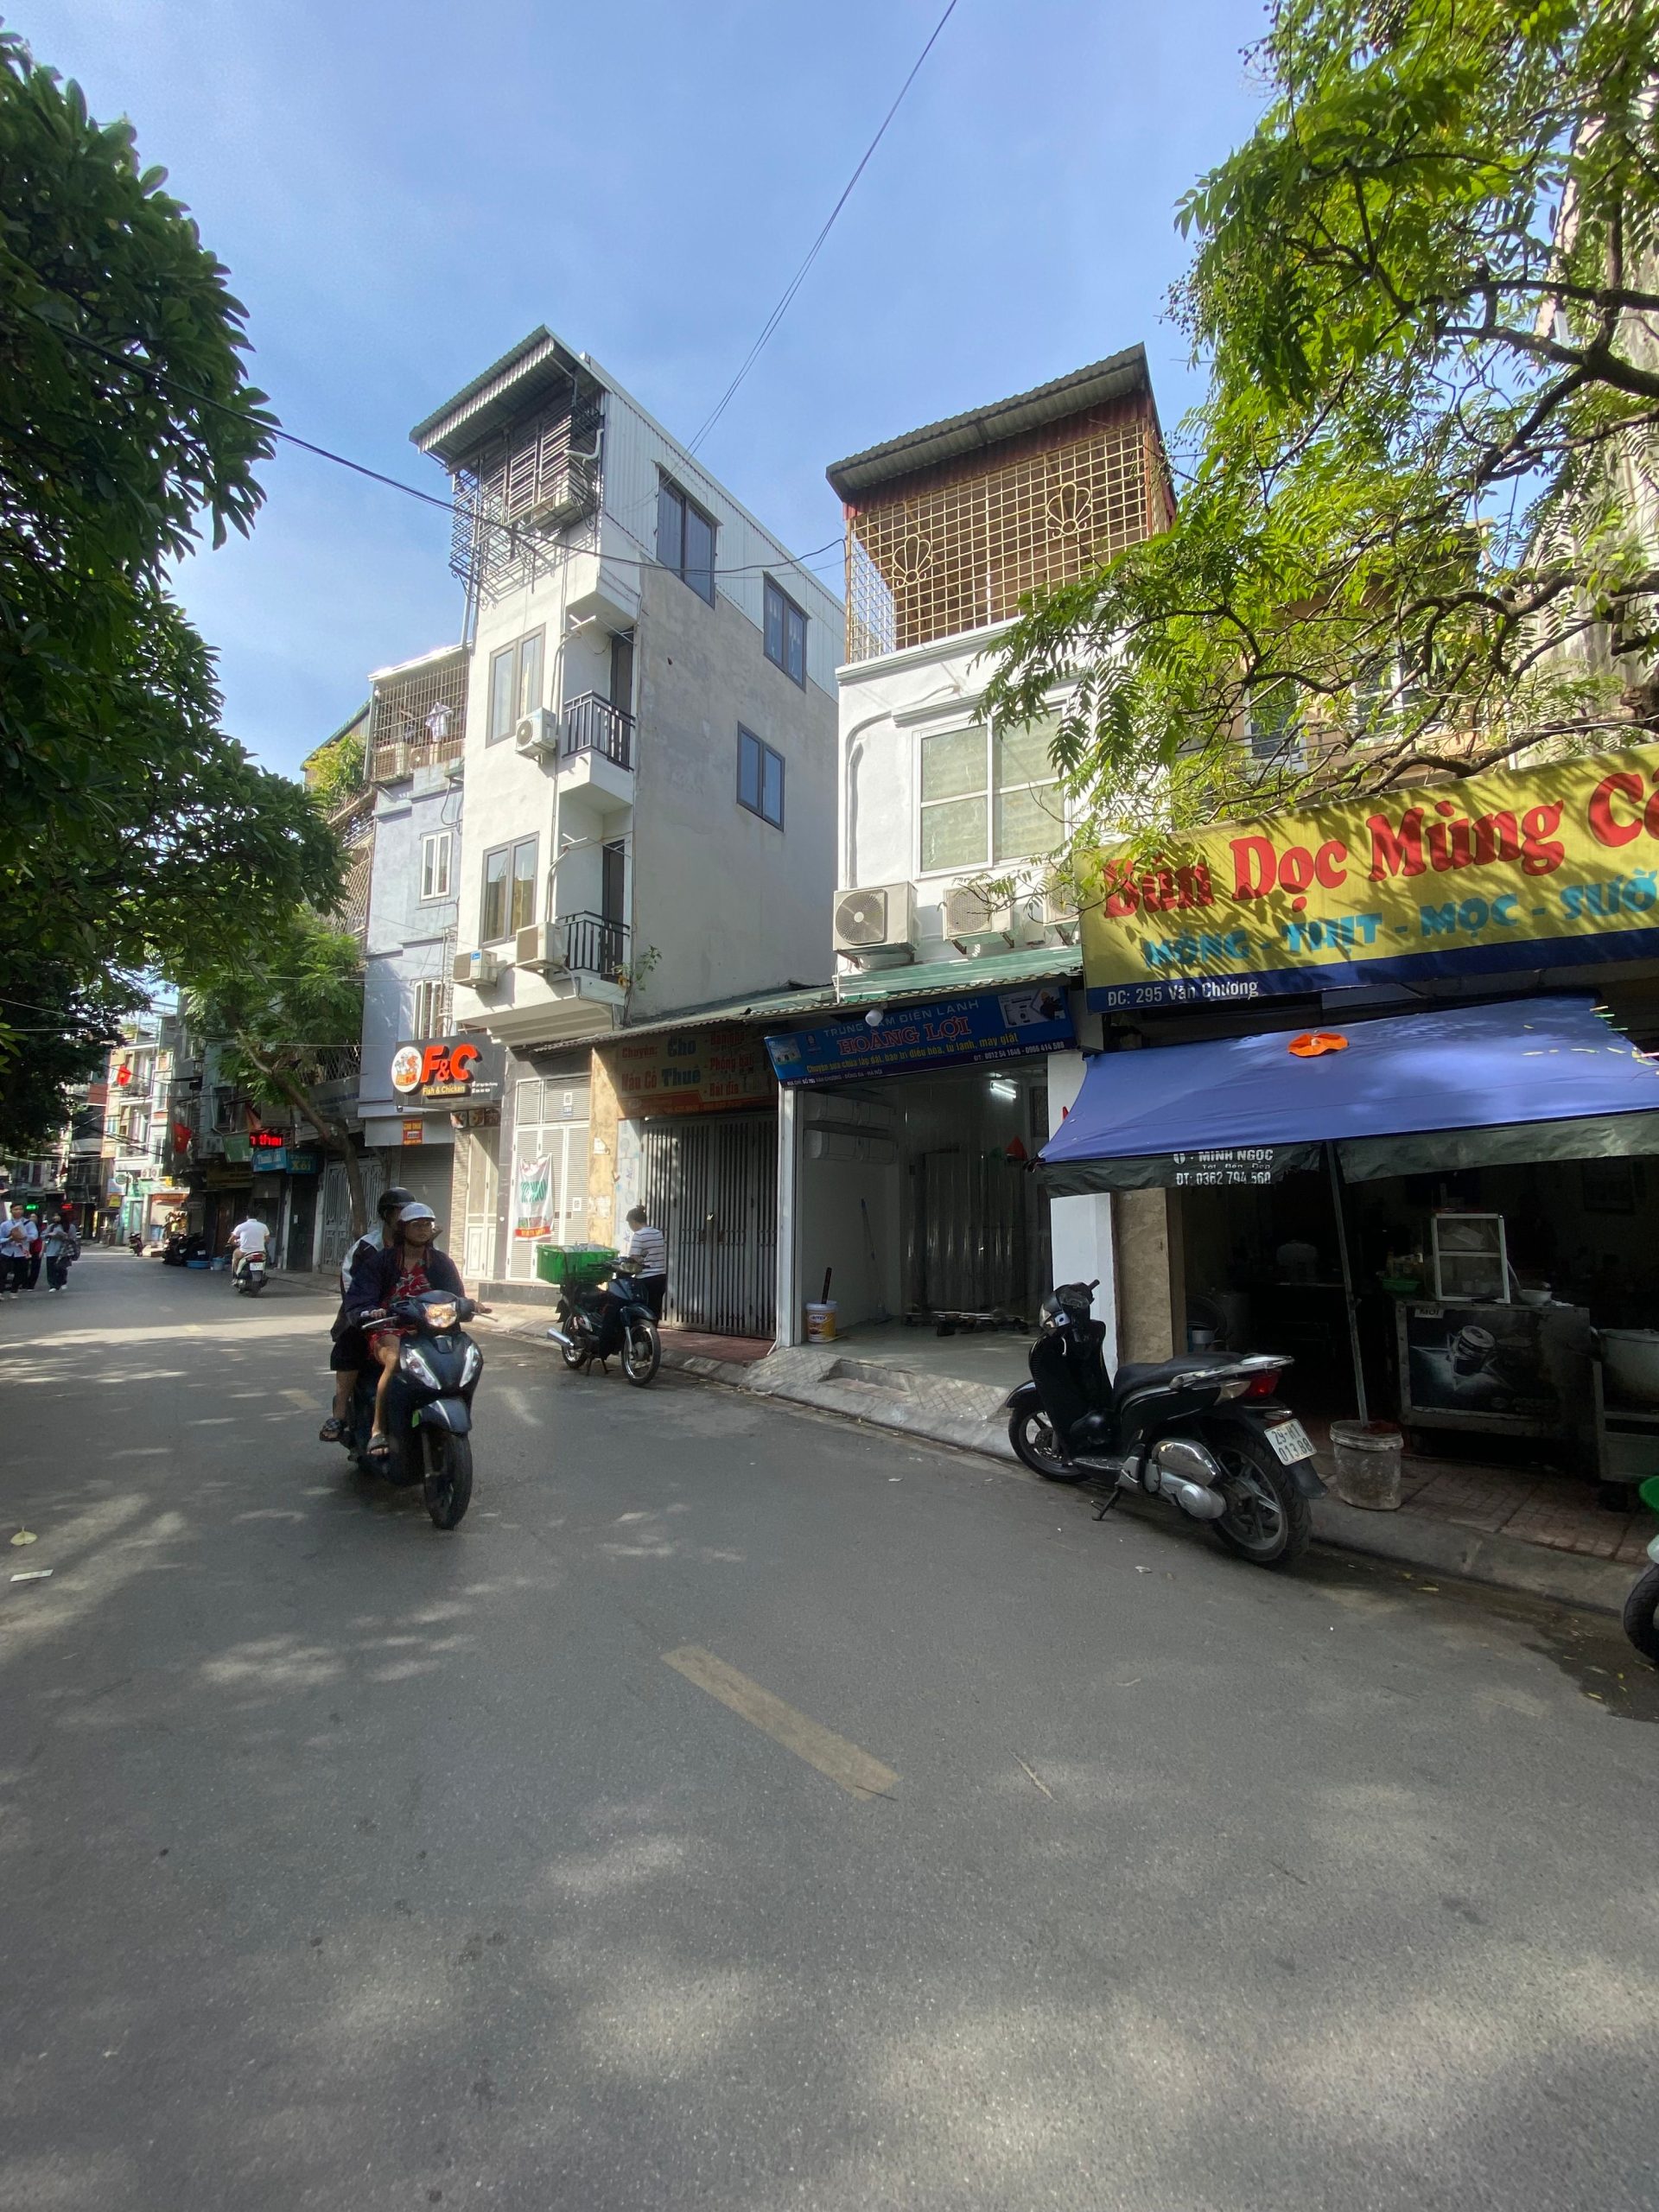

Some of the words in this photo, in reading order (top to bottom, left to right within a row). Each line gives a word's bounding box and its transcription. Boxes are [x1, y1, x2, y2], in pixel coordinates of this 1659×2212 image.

[1230, 836, 1348, 912] Dọc
[1420, 893, 1518, 938] MỌC
[1107, 991, 1131, 1007] ĐC:
[1135, 987, 1163, 1004] 295
[1168, 983, 1197, 1001] Văn
[1201, 981, 1259, 1001] Chương
[824, 1024, 863, 1038] TRUNG
[837, 1027, 919, 1055] HOÀNG
[925, 1016, 971, 1041] LỢI
[667, 1036, 696, 1058] Cho
[420, 1044, 479, 1084] F&C
[662, 1065, 701, 1086] Thuê
[423, 1087, 435, 1096] Fish
[441, 1084, 466, 1094] Chicken
[1198, 1150, 1233, 1162] MINH
[1236, 1149, 1274, 1163] NGỌC
[1176, 1173, 1193, 1185] ĐT:
[1196, 1171, 1224, 1185] 0362
[1225, 1171, 1247, 1185] 794
[1279, 1437, 1313, 1461] 013.88
